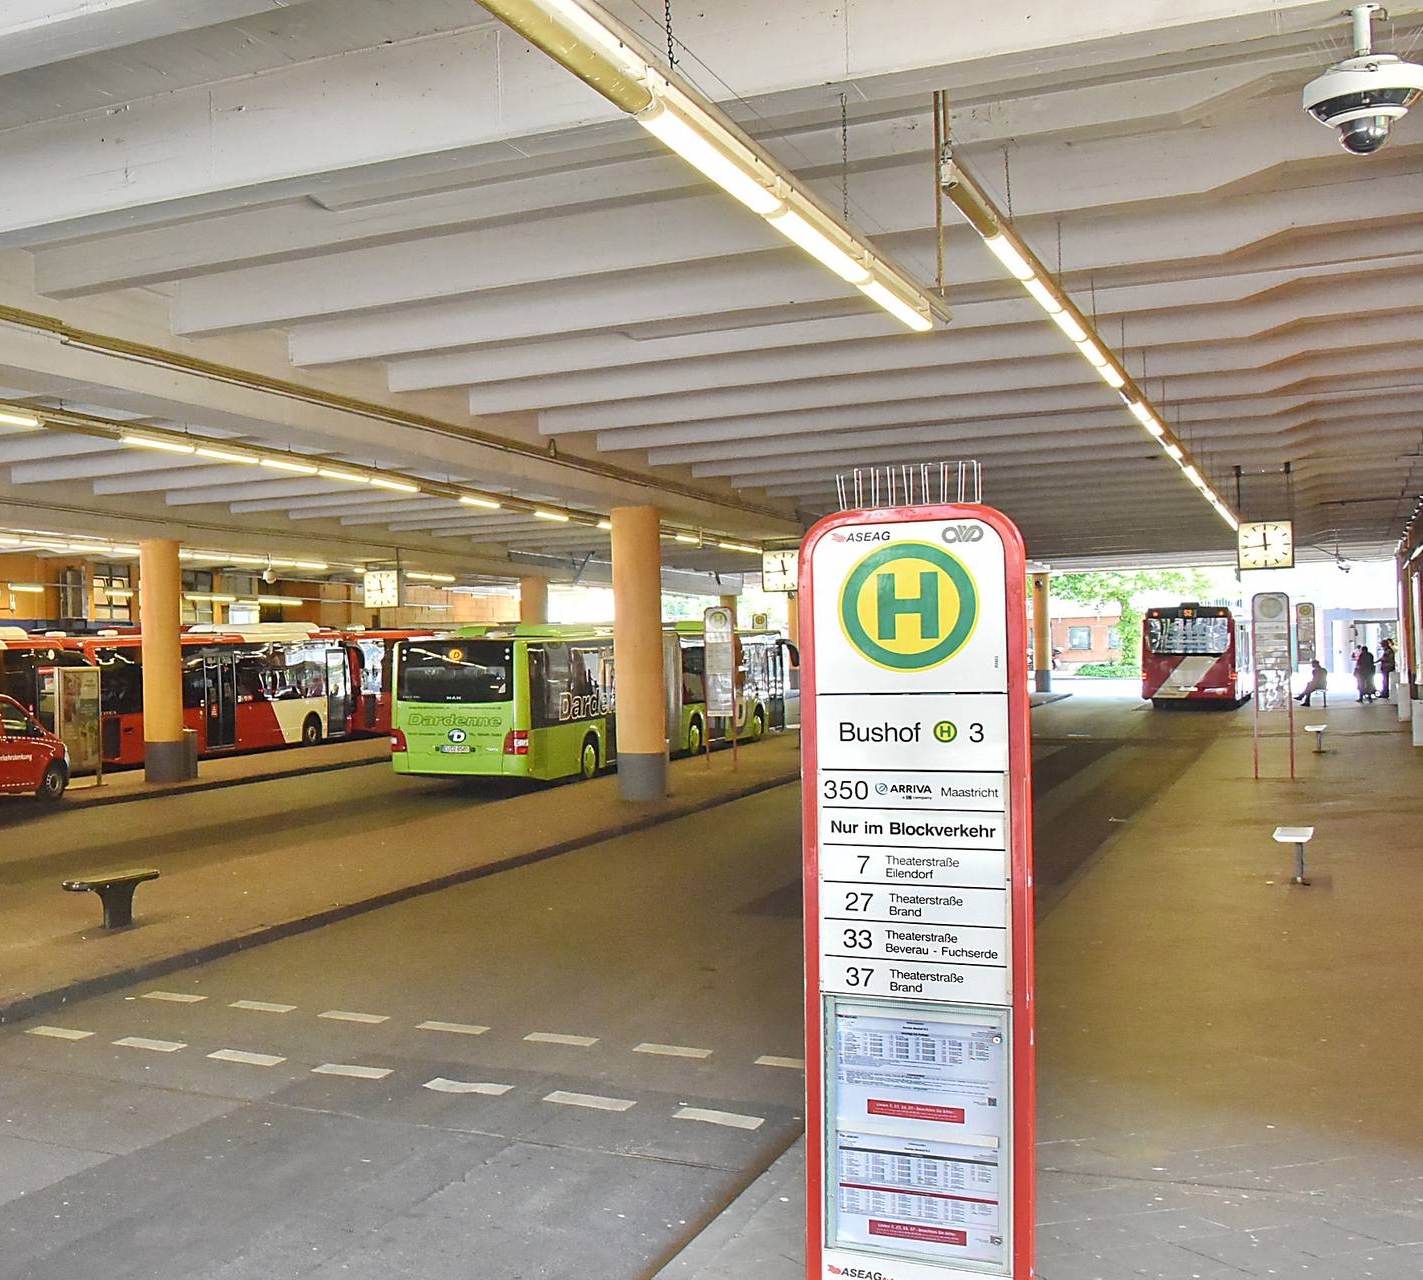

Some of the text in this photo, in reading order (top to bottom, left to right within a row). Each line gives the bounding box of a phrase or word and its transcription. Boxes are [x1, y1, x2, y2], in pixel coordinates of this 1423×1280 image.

[846, 531, 891, 543] ASEAG
[408, 713, 502, 728] Dardenne
[839, 721, 921, 742] Bushof
[969, 722, 985, 743] 3
[823, 780, 999, 800] 350 ARRIVA Maastricht
[830, 820, 997, 838] Nur im Blockverkehr
[856, 855, 960, 874] 7 Theaterstraße
[885, 867, 934, 880] Eilendorf
[844, 892, 964, 912] 27 Theaterstraße
[889, 905, 922, 917] Brand
[842, 928, 958, 949] 33 Theaterstraße
[885, 943, 929, 955] Beverau
[941, 946, 998, 960] Fuchserde
[845, 967, 964, 987] 37 Theaterstraße
[889, 981, 923, 993] Brand
[841, 1267, 882, 1280] ASEAG
